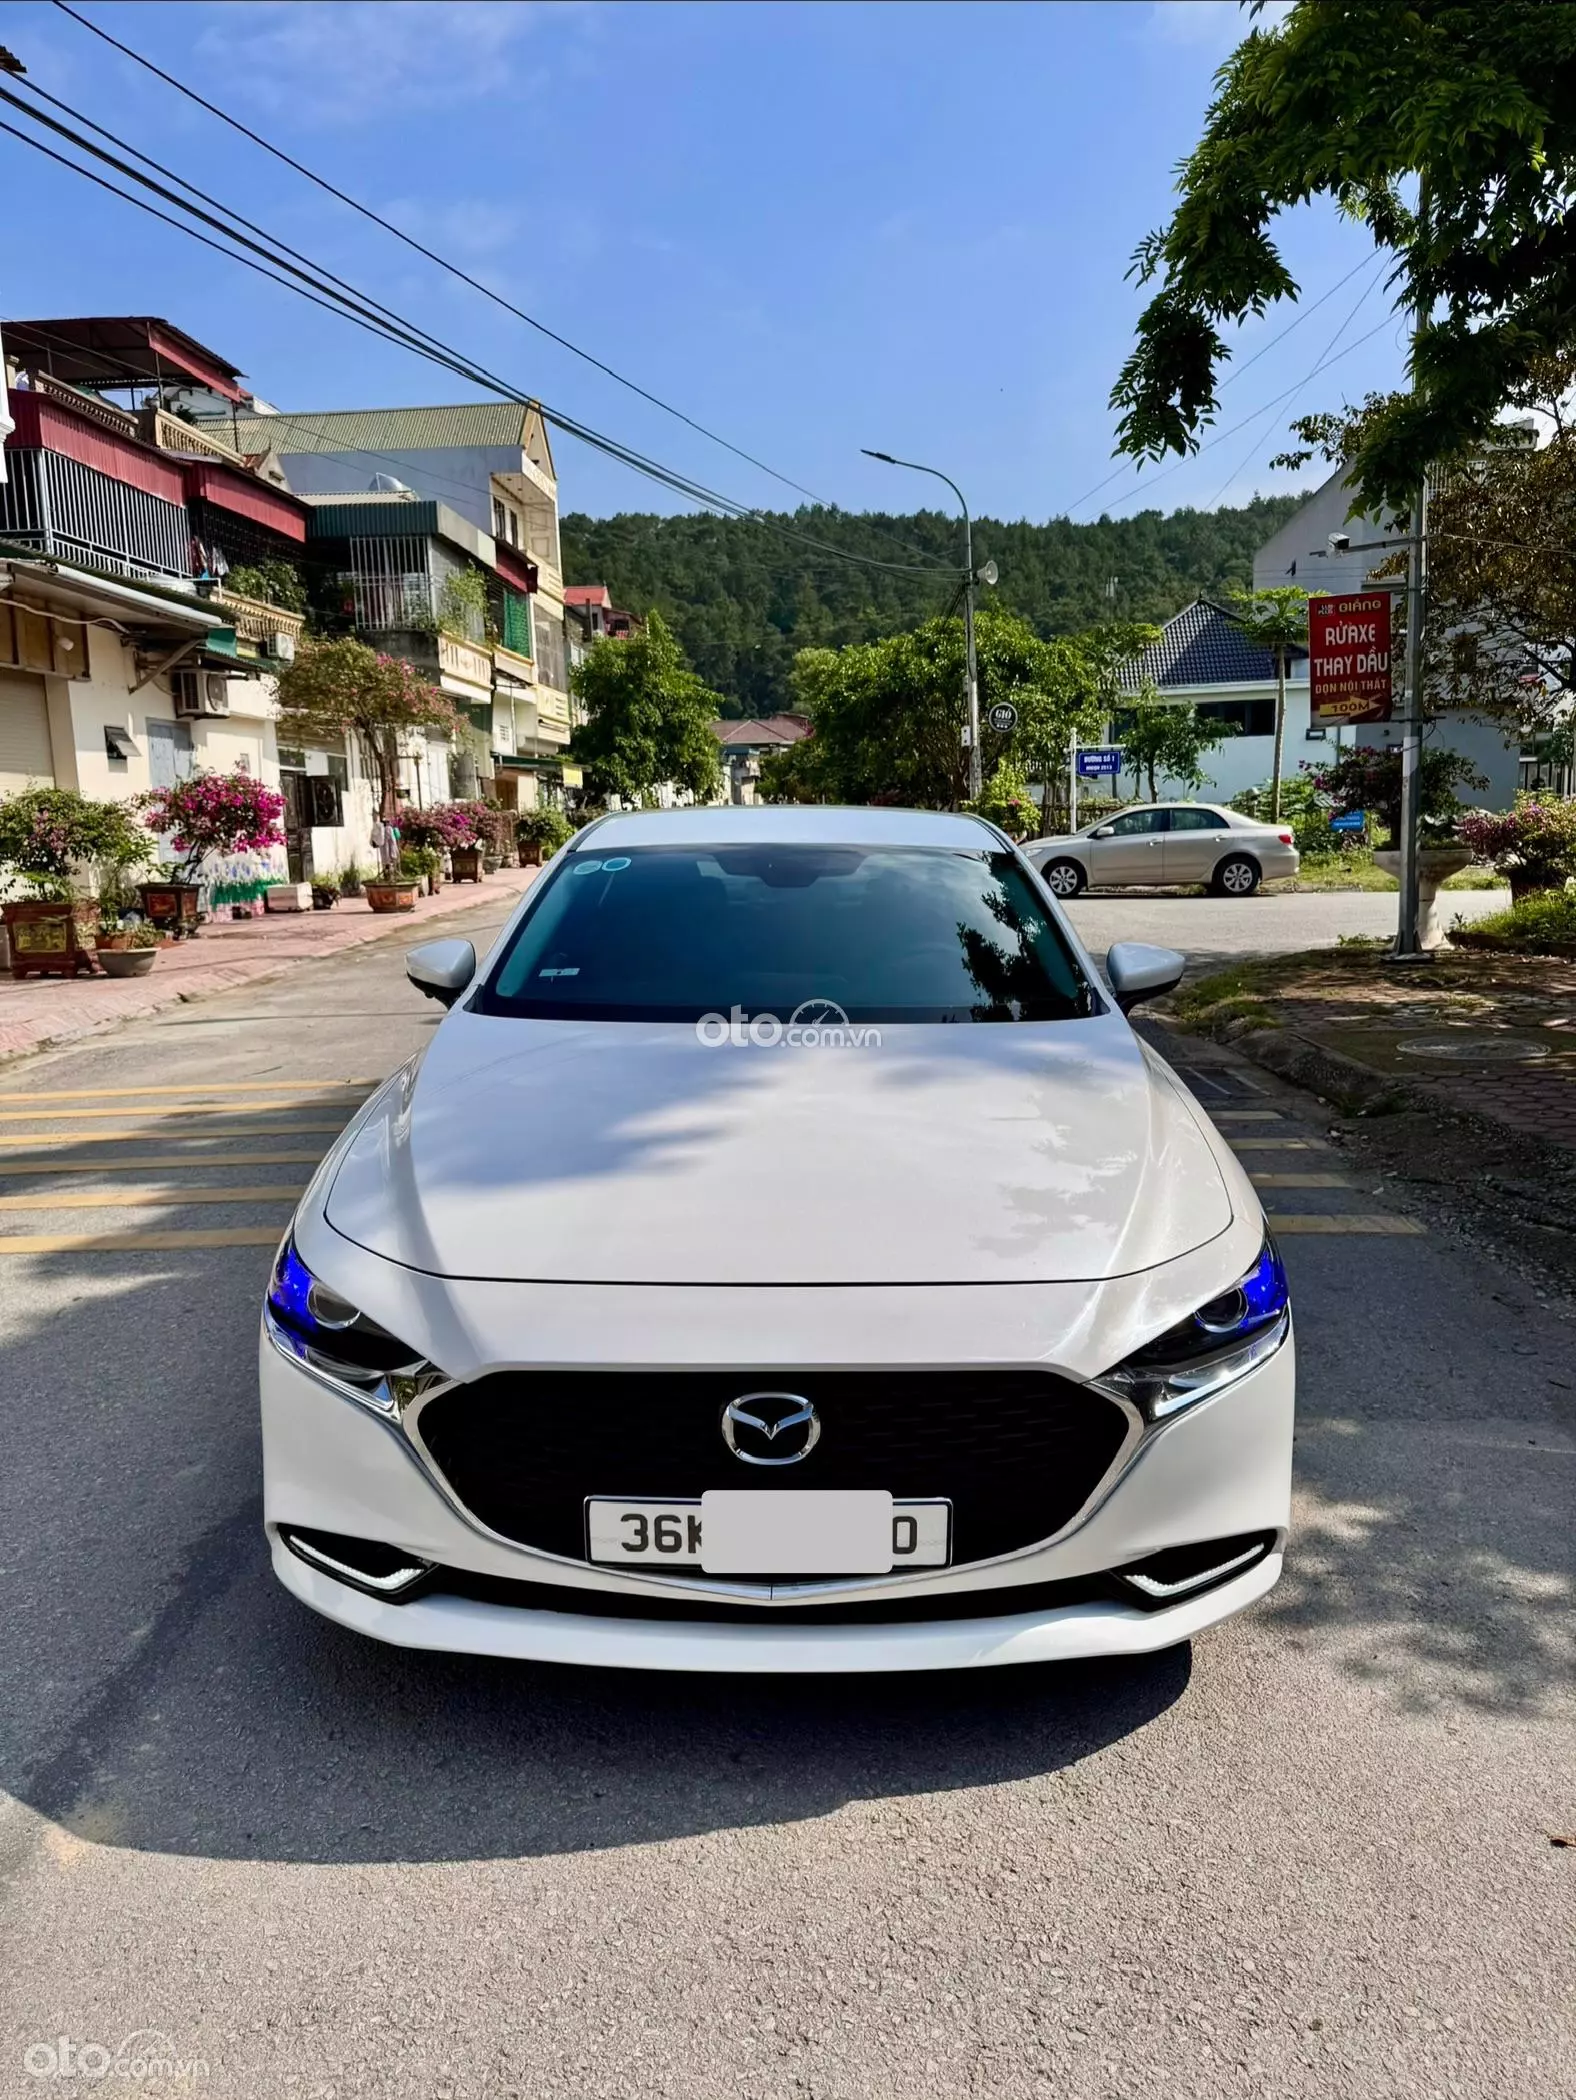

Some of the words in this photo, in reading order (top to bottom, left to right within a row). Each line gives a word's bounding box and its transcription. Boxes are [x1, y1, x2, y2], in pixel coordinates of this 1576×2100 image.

[1314, 654, 1353, 677] THAY
[1356, 645, 1388, 674] DẦU
[1340, 679, 1358, 694] NỘI
[1360, 675, 1387, 691] THẤT
[1331, 701, 1370, 714] 100M
